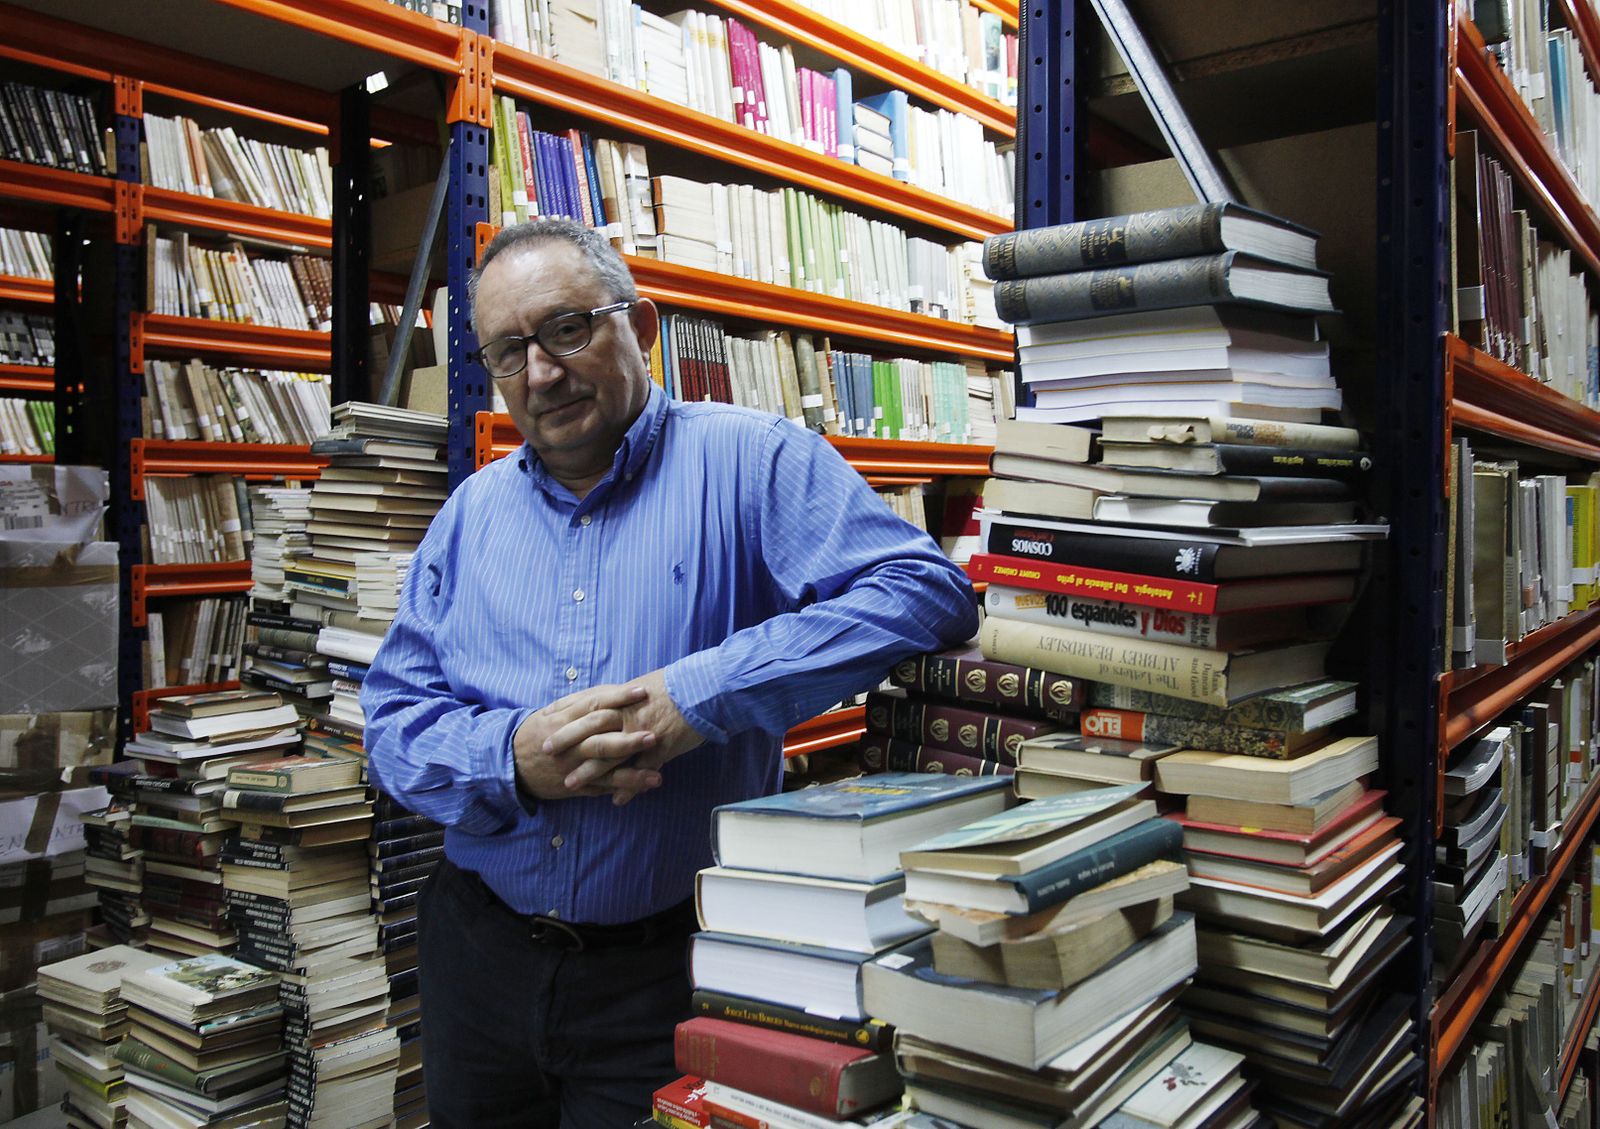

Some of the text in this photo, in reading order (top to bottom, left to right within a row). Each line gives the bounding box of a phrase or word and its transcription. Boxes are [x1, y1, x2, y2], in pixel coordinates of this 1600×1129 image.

[1012, 538, 1053, 556] COSMOS
[1018, 569, 1041, 580] CHUMY
[1056, 574, 1075, 585] grito
[1075, 577, 1083, 587] al
[1084, 578, 1113, 592] silencio
[1115, 584, 1128, 593] Del
[1046, 593, 1185, 635] 100 españoles y Dios
[1036, 635, 1180, 672] AUBREY BEARDSLEY
[1100, 663, 1179, 690] The Letters of
